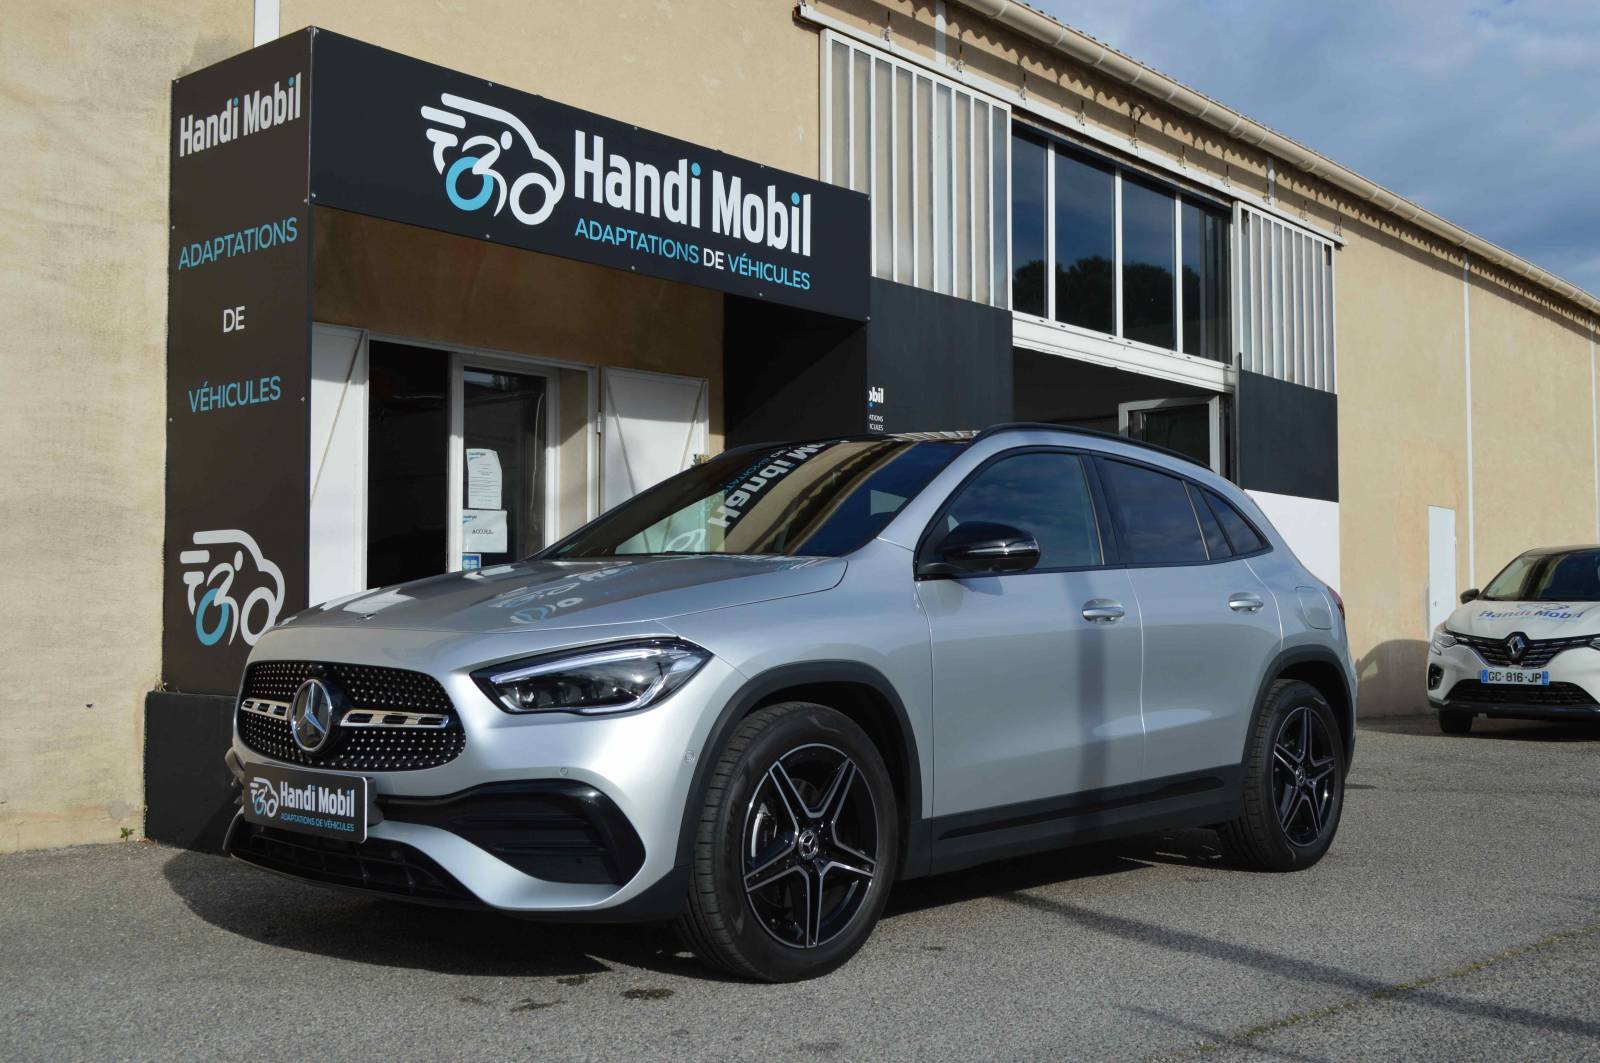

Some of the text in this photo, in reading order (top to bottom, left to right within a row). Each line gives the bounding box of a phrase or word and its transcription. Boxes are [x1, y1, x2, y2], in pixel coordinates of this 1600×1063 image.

[179, 71, 302, 157] Handi Mobil
[574, 129, 812, 257] Handi Mobil
[178, 216, 298, 270] ADAPTATIONS
[574, 217, 811, 290] ADAPTATIONS DE VÉHICULES
[223, 305, 246, 333] DE
[188, 375, 282, 413] VÉHICULES
[1533, 609, 1585, 619] Mobil
[280, 781, 355, 818] Handi Mobil
[280, 812, 315, 825] ADAPTATIONS
[315, 818, 324, 828] DE
